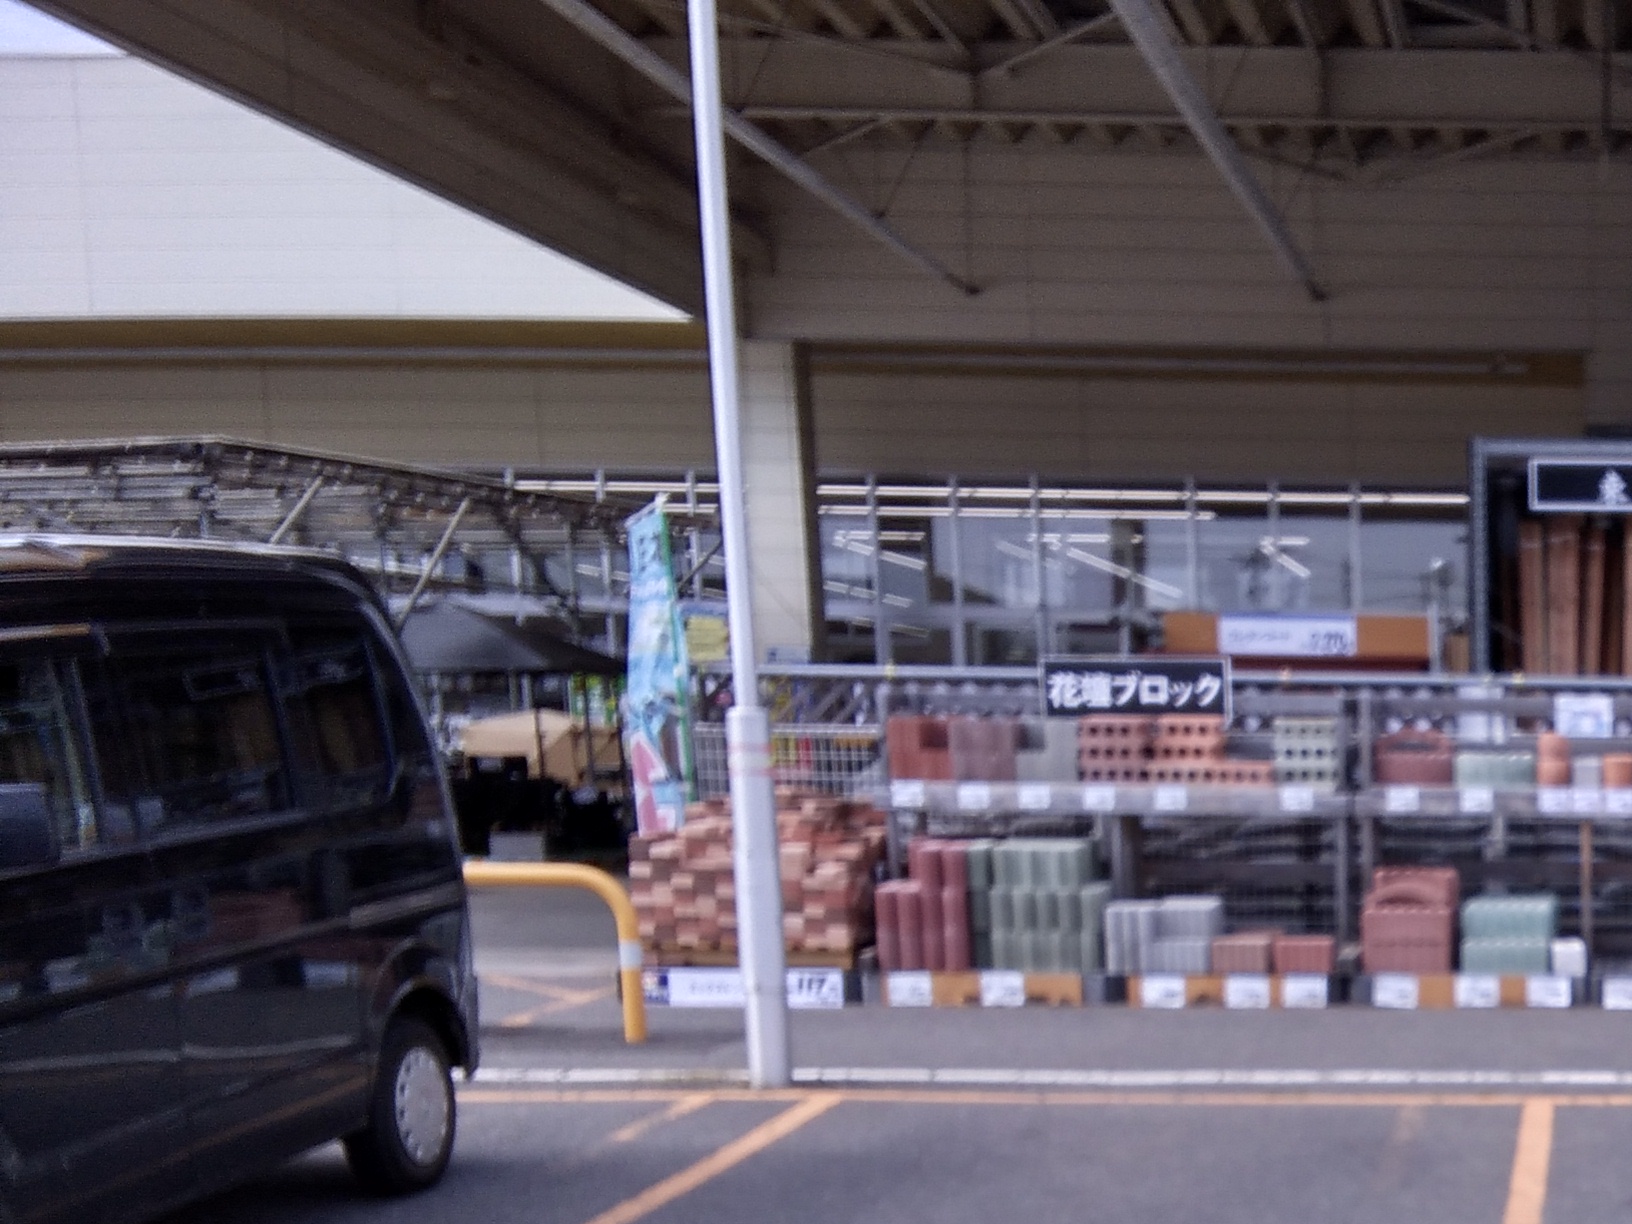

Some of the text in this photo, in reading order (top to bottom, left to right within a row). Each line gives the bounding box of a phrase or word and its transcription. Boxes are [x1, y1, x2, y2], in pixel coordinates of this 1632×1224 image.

[1047, 670, 1222, 708] 花壇ブロック
